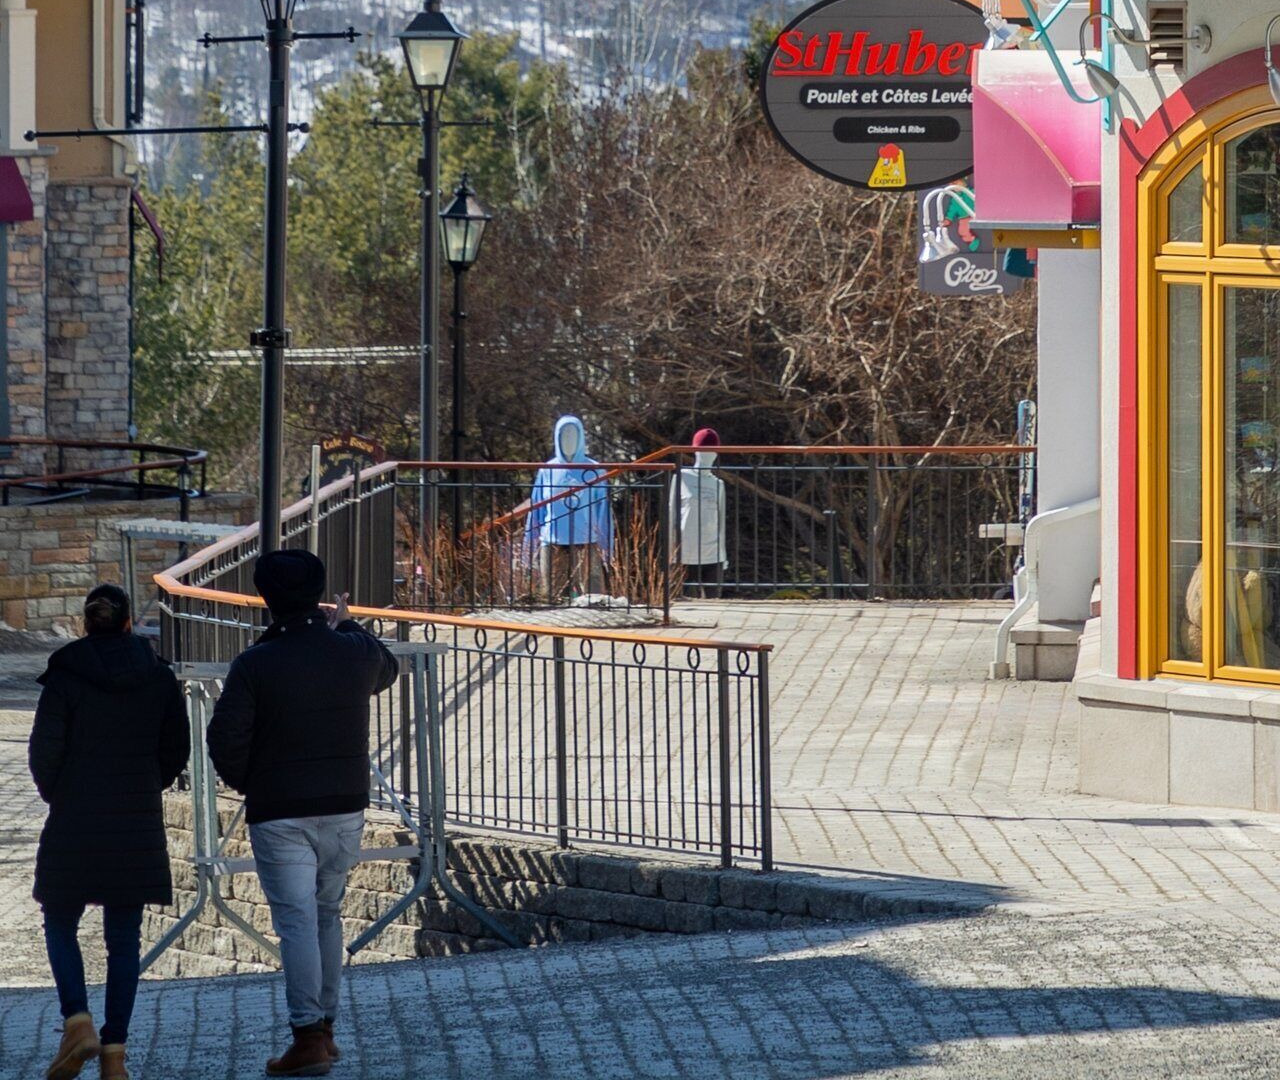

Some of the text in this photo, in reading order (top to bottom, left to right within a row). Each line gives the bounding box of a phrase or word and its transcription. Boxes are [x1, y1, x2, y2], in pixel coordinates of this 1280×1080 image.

[806, 87, 974, 104] Poulet et Côtes Levée
[867, 125, 926, 134] Chicken & Ribs
